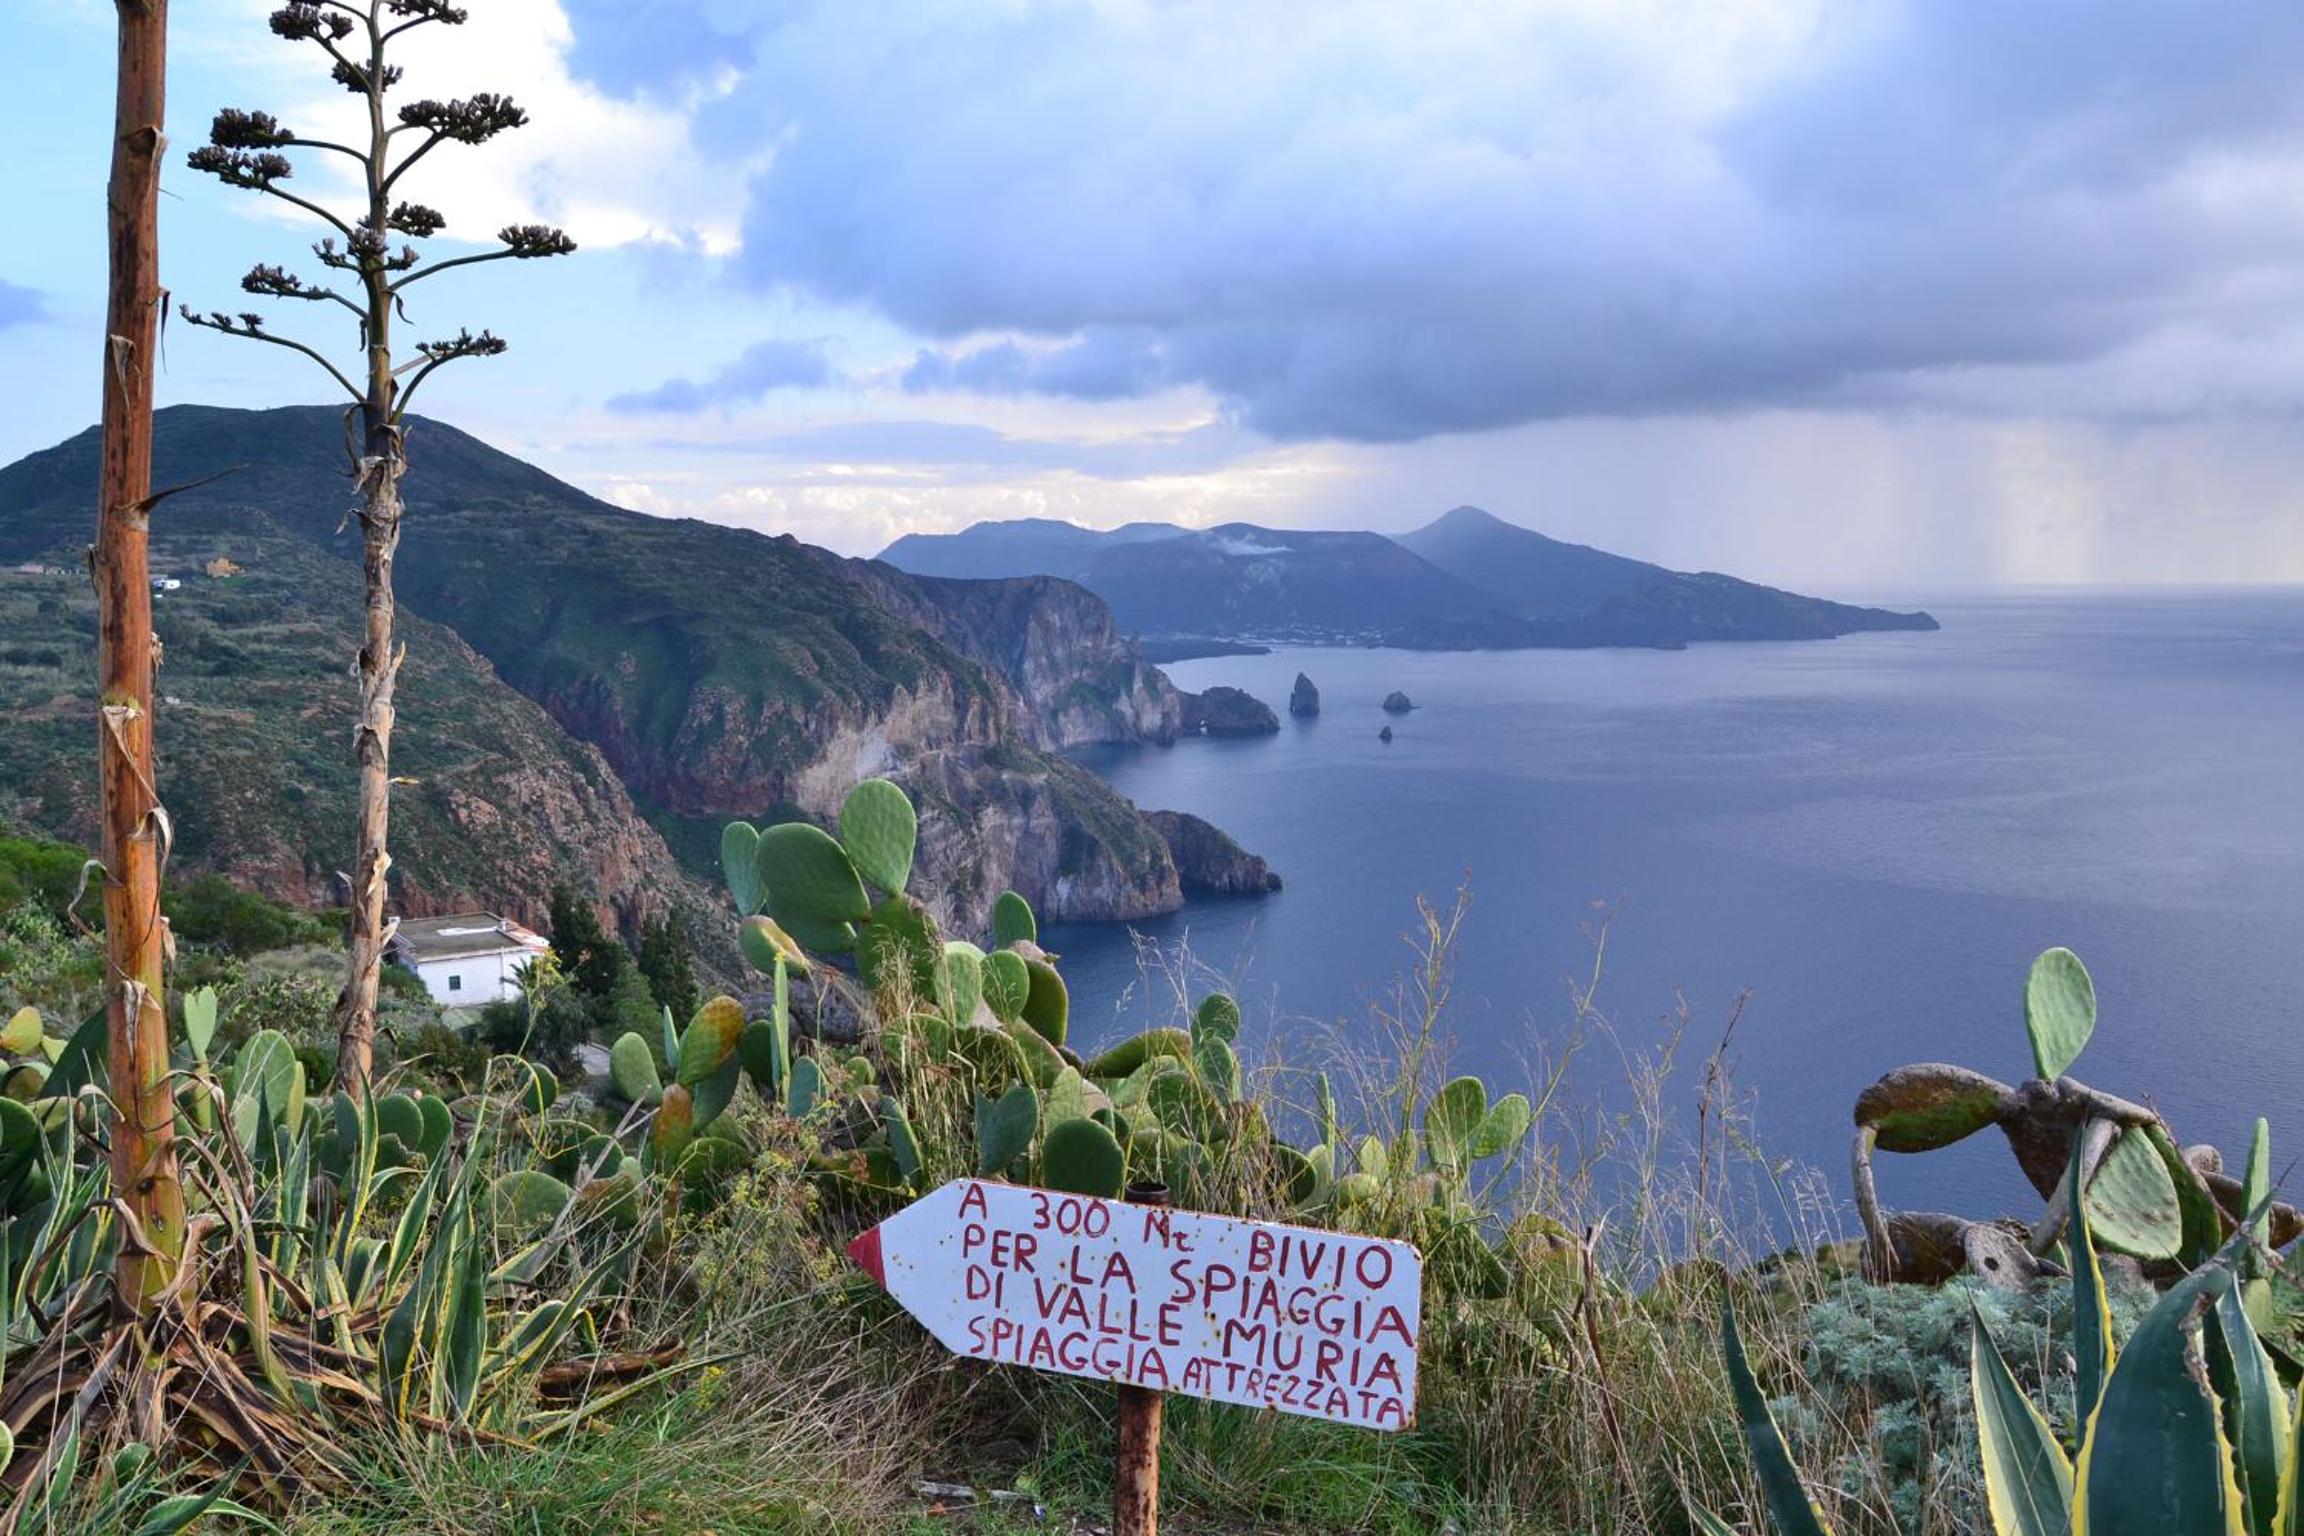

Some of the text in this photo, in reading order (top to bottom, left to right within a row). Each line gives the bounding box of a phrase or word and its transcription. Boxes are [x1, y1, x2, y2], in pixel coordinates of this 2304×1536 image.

[958, 1182, 988, 1220] A
[1030, 1192, 1111, 1238] 300
[1248, 1229, 1393, 1290] BIVIO
[963, 1223, 1414, 1348] PER LA SPIAGGIA
[966, 1264, 1403, 1394] DI VALLE MURIA
[968, 1315, 1407, 1427] SPIAGGIA ATTREZZATA
